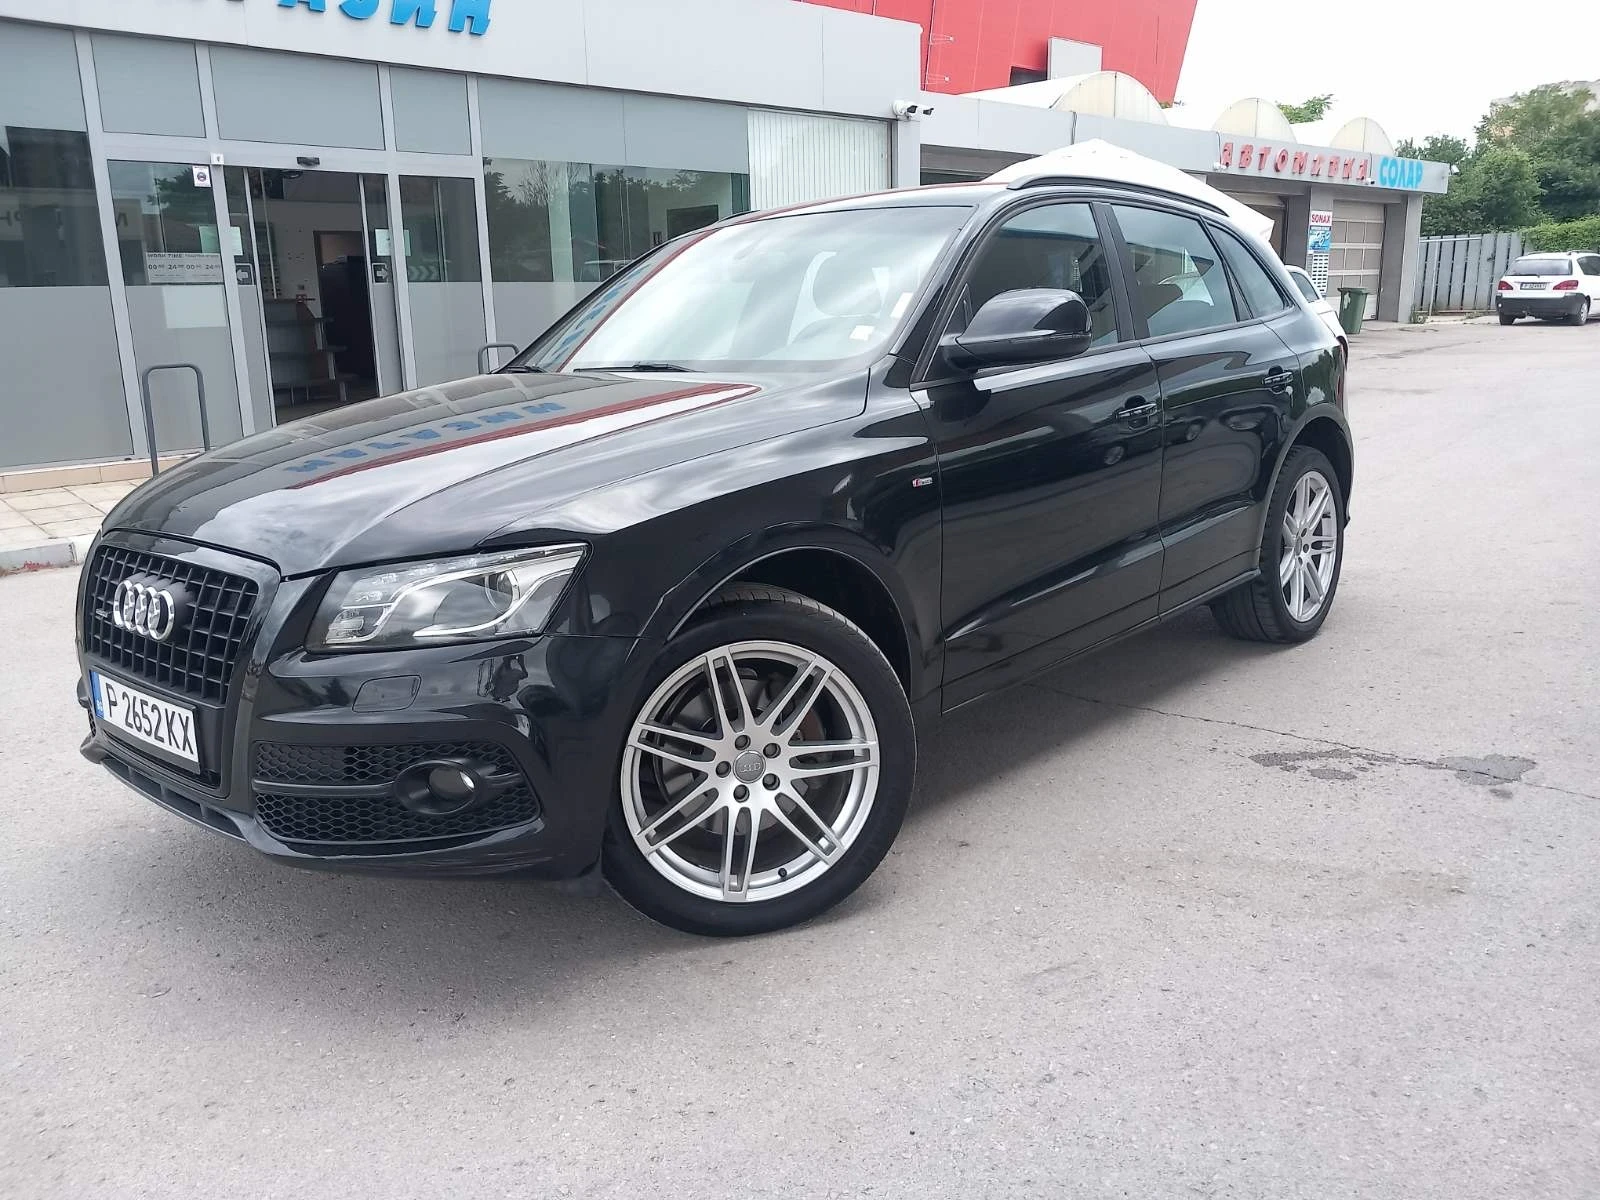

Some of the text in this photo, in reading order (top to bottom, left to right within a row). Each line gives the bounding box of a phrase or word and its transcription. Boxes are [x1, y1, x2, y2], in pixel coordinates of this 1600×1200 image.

[1379, 156, 1424, 189] СОЛАР
[1311, 214, 1330, 223] SONAX
[105, 682, 194, 755] P 2652KX
